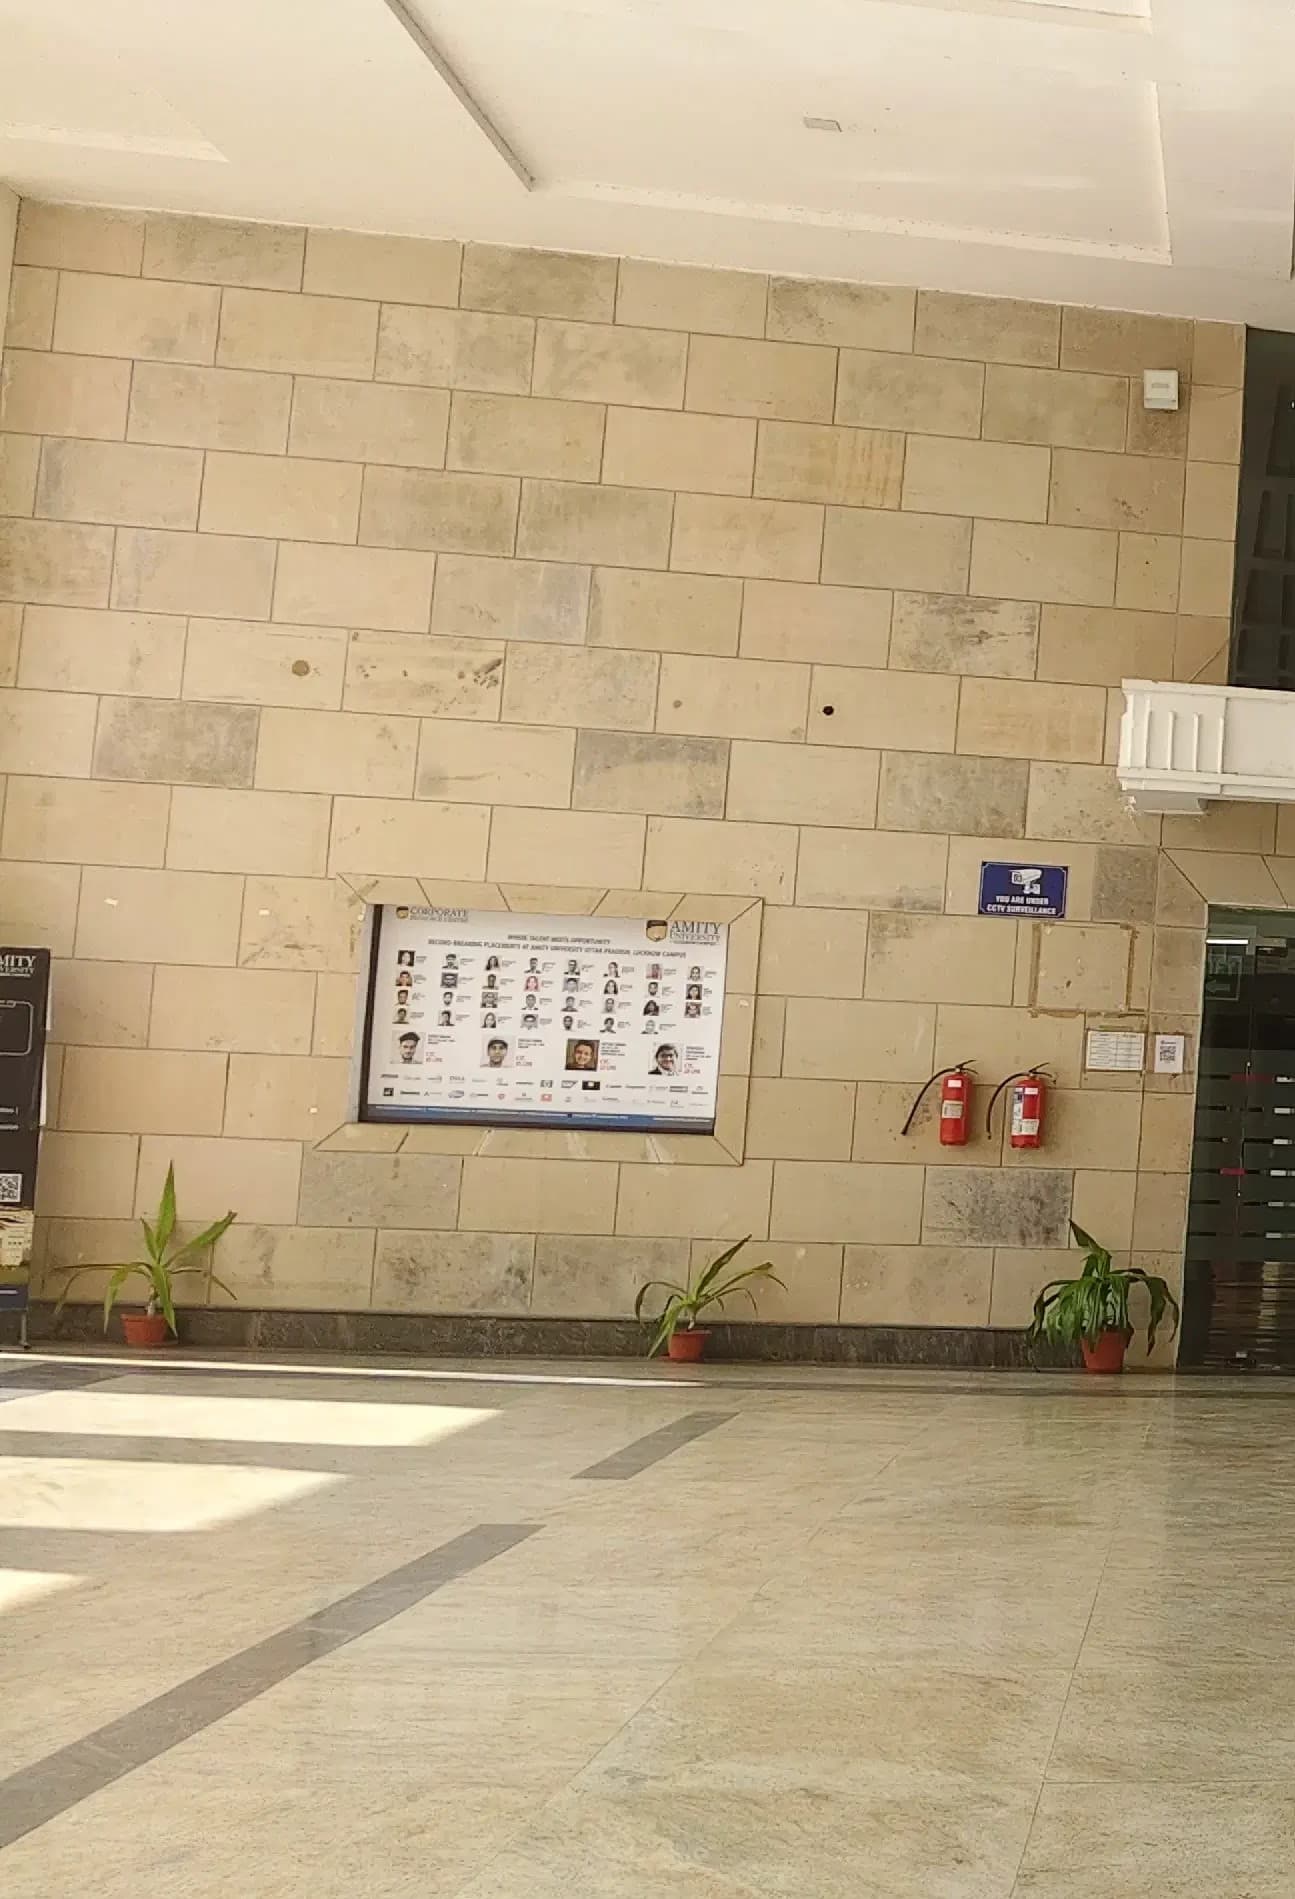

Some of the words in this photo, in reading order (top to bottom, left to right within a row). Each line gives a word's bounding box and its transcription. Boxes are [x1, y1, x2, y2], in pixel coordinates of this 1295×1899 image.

[995, 895, 1011, 903] YOU
[1010, 896, 1025, 904] ARE
[1025, 897, 1049, 905] UNDER
[986, 903, 1006, 913] CCTV
[1005, 905, 1057, 915] SURVEILLANCE
[672, 920, 723, 934] AMITY
[670, 930, 721, 943] UNIVERSITY
[0, 954, 37, 967] MITY
